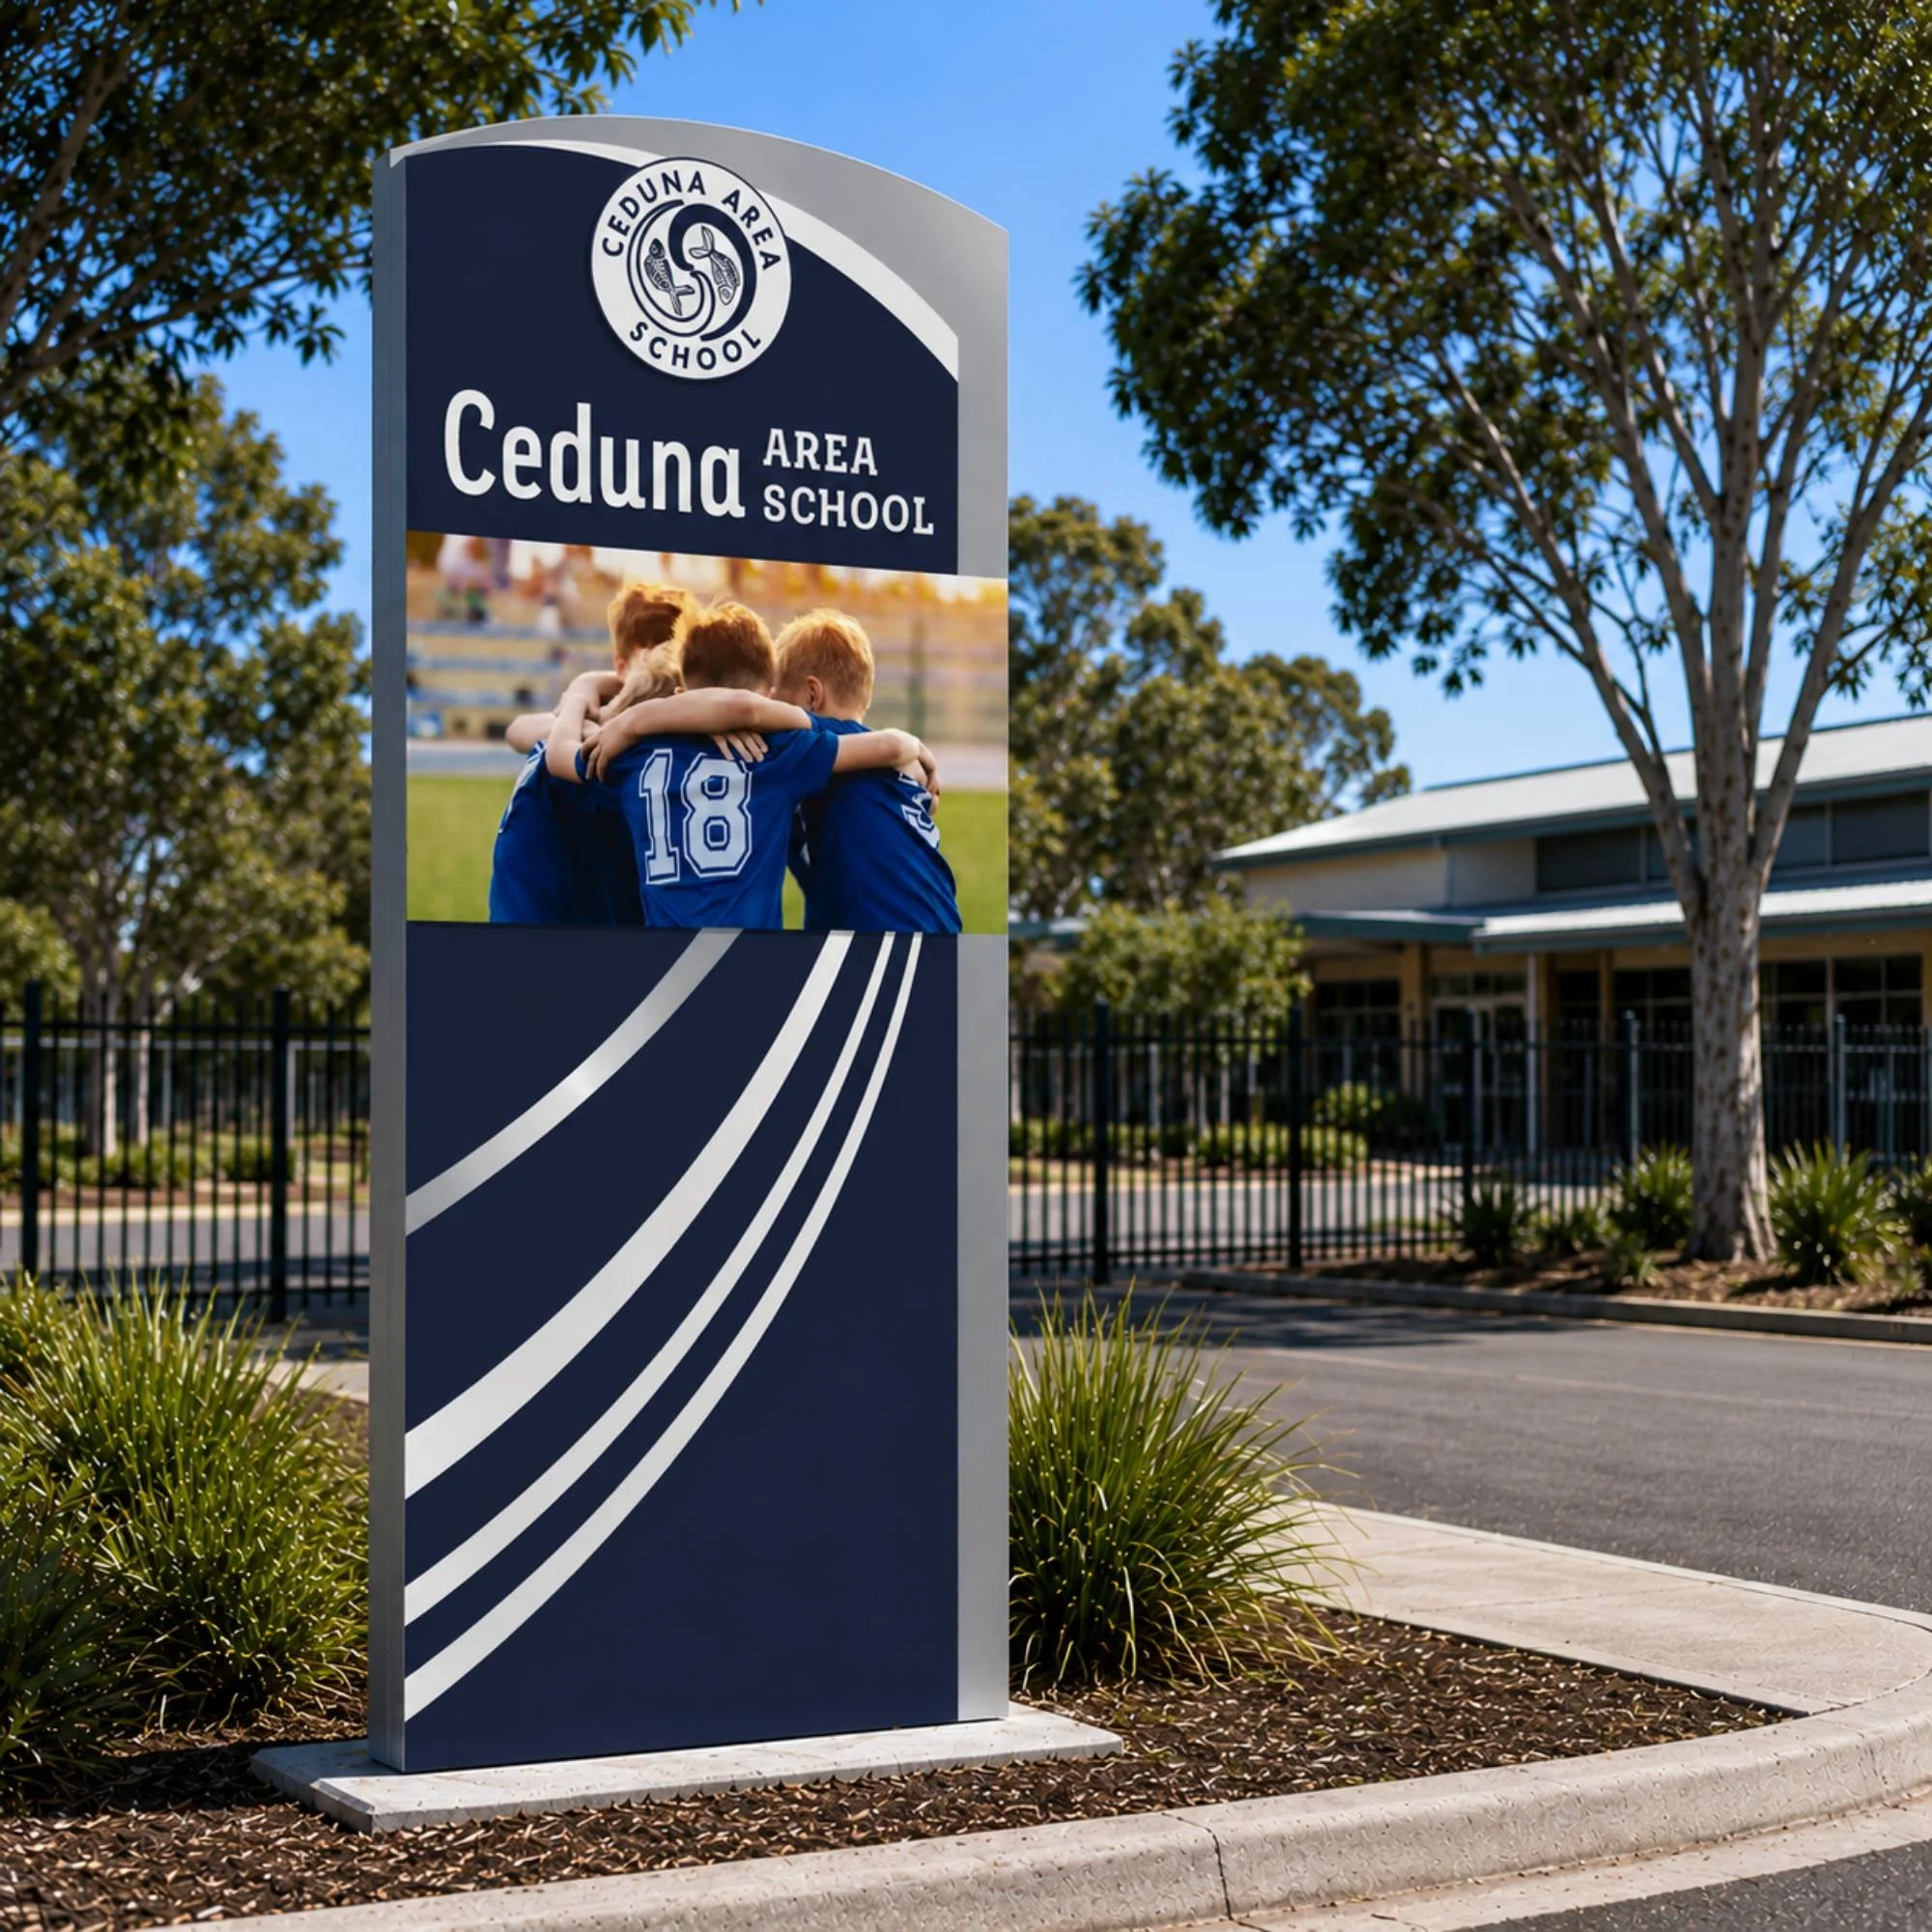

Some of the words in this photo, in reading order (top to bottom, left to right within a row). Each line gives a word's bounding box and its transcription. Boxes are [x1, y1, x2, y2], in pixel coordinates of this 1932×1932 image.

[602, 169, 707, 257] CEDUNA
[722, 188, 781, 270] AREA
[630, 321, 761, 370] SCHOOL
[443, 388, 746, 518] Ceduna
[762, 427, 879, 477] AREA
[762, 483, 935, 535] SCHOOL
[639, 748, 753, 885] 18
